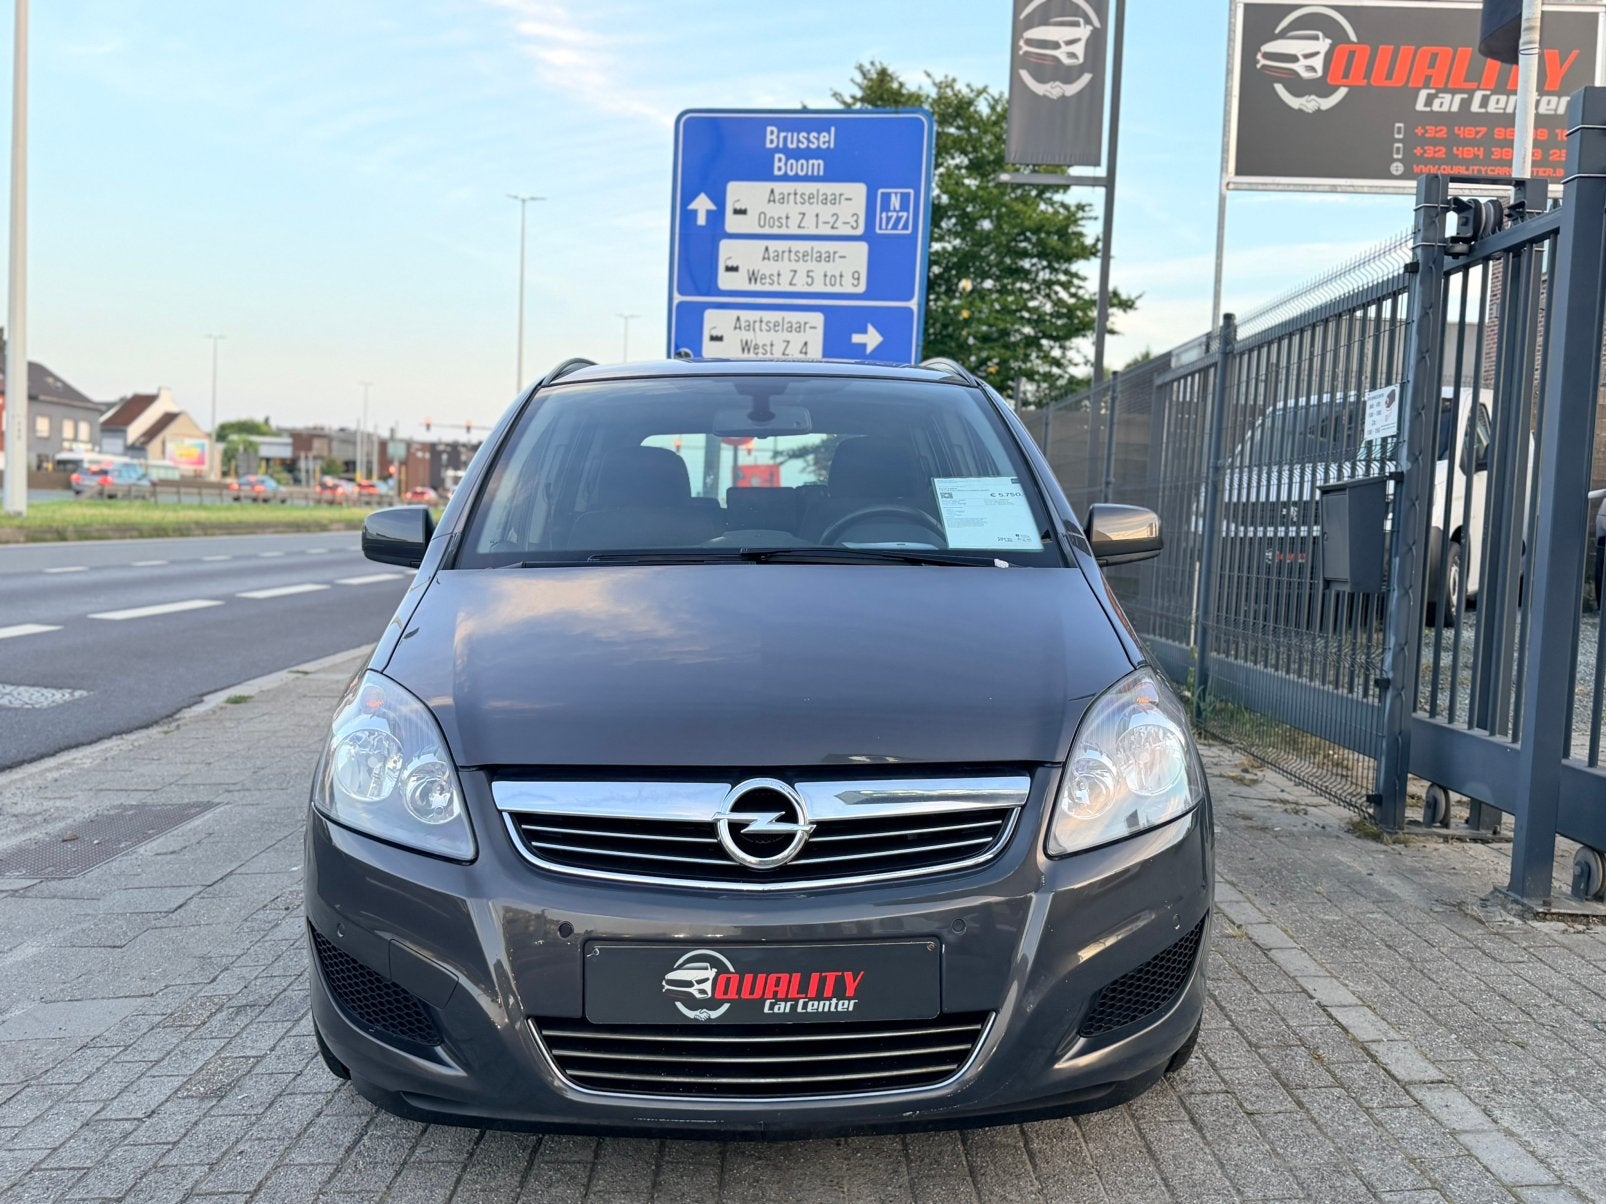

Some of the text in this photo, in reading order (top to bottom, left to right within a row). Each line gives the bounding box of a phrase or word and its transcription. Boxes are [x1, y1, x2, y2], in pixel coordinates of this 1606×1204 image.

[1415, 89, 1468, 112] Car
[765, 126, 836, 149] Brussel
[1415, 125, 1447, 139] +32
[1454, 126, 1488, 139] 487
[1413, 145, 1446, 159] +32
[1453, 146, 1484, 160] 484
[773, 153, 824, 176] Boom
[767, 187, 853, 206] Aartselaar-
[890, 192, 900, 211] N
[757, 211, 790, 229] Oost
[881, 212, 908, 230] 177
[761, 245, 847, 263] Aartselaar-
[747, 269, 782, 286] West
[823, 271, 844, 287] tot
[851, 270, 861, 288] 9
[733, 315, 817, 333] Aartselaar-
[740, 338, 775, 356] West
[714, 971, 864, 1000] QUALITY
[764, 998, 858, 1014] Car Center
